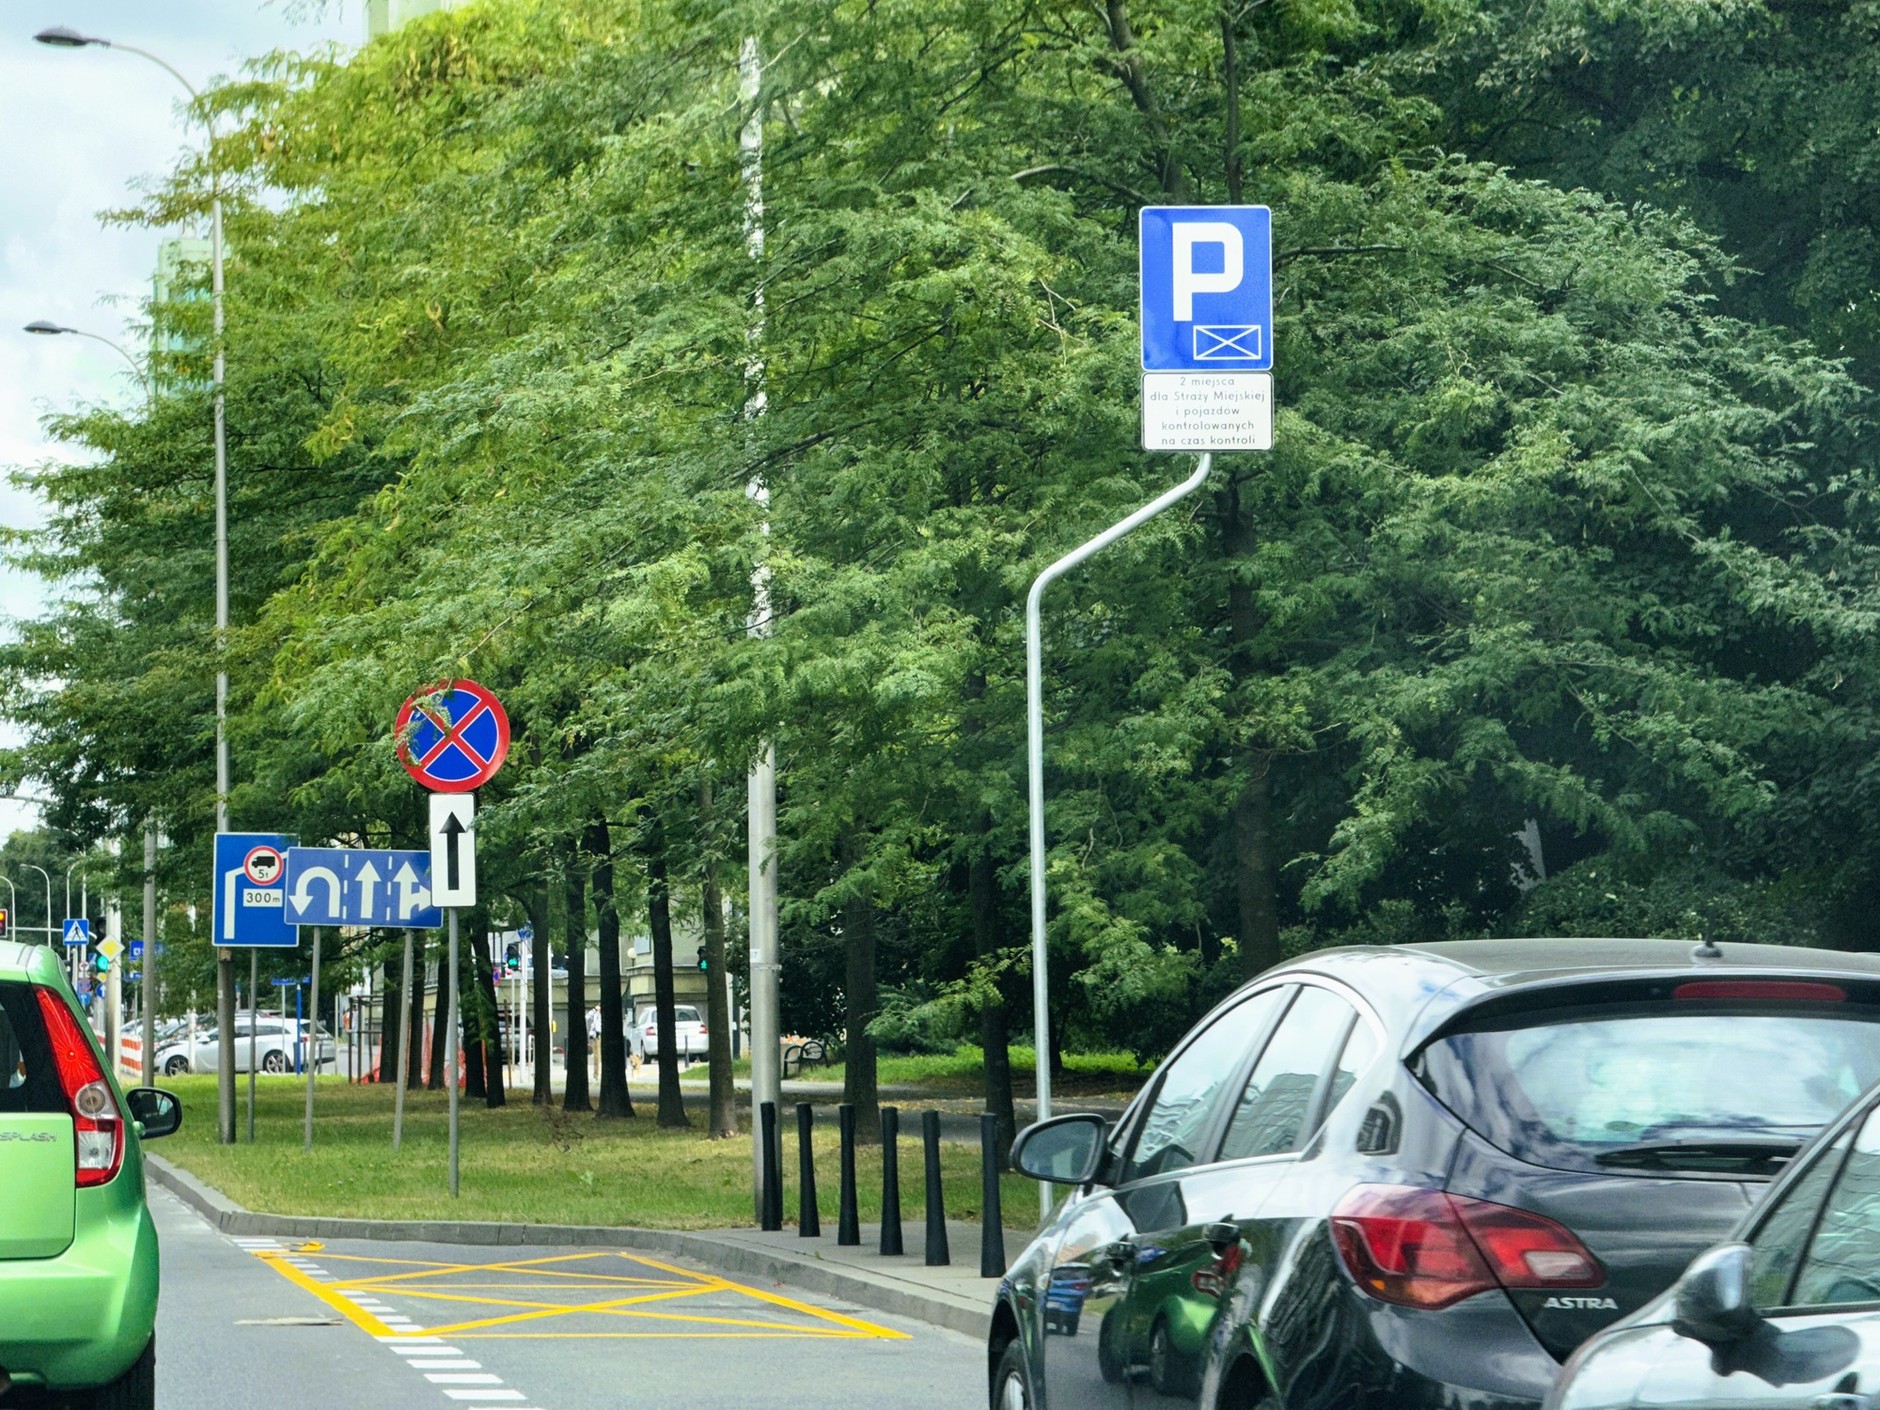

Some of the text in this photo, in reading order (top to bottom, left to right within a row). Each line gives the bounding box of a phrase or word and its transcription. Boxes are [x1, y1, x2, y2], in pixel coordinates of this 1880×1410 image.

[1172, 222, 1243, 321] P
[1180, 377, 1235, 388] 2 miejsca
[1150, 390, 1265, 403] dla Straży Miejskiej
[1161, 420, 1254, 432] kontrolowanych
[1181, 437, 1205, 445] czas
[1210, 435, 1255, 445] kontroli
[1543, 1297, 1618, 1310] ASTRA
